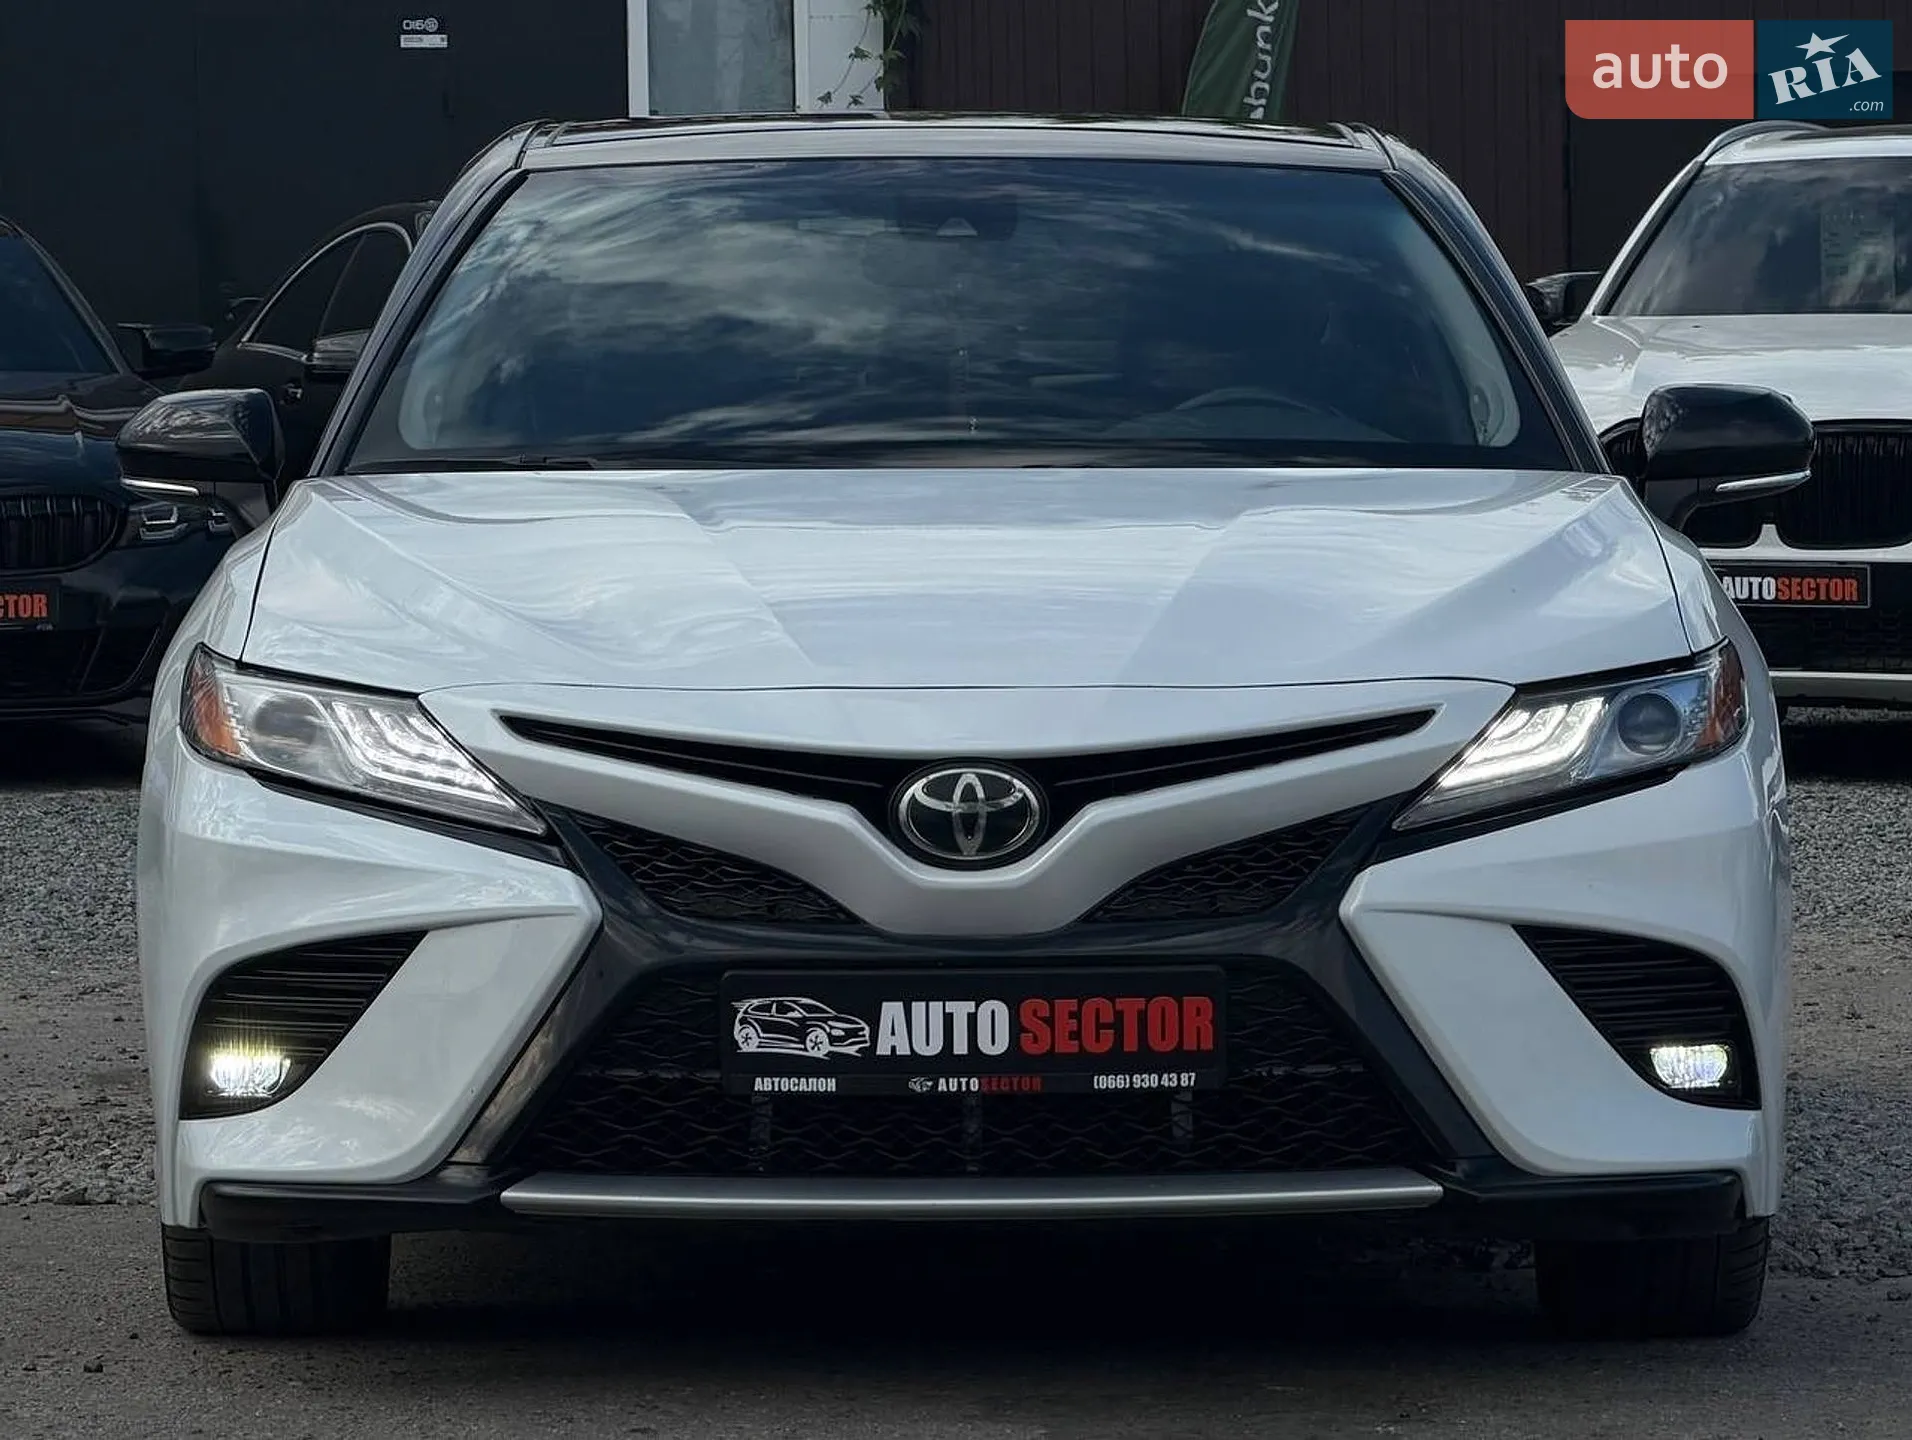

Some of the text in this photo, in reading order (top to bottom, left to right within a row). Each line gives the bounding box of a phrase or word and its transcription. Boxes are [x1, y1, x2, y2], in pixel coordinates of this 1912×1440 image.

[1243, 0, 1279, 119] bunk
[875, 996, 1214, 1056] AUTO SECTOR
[754, 1077, 836, 1092] АВТОСАЛОН
[1093, 1072, 1196, 1089] (066) 930 43 87
